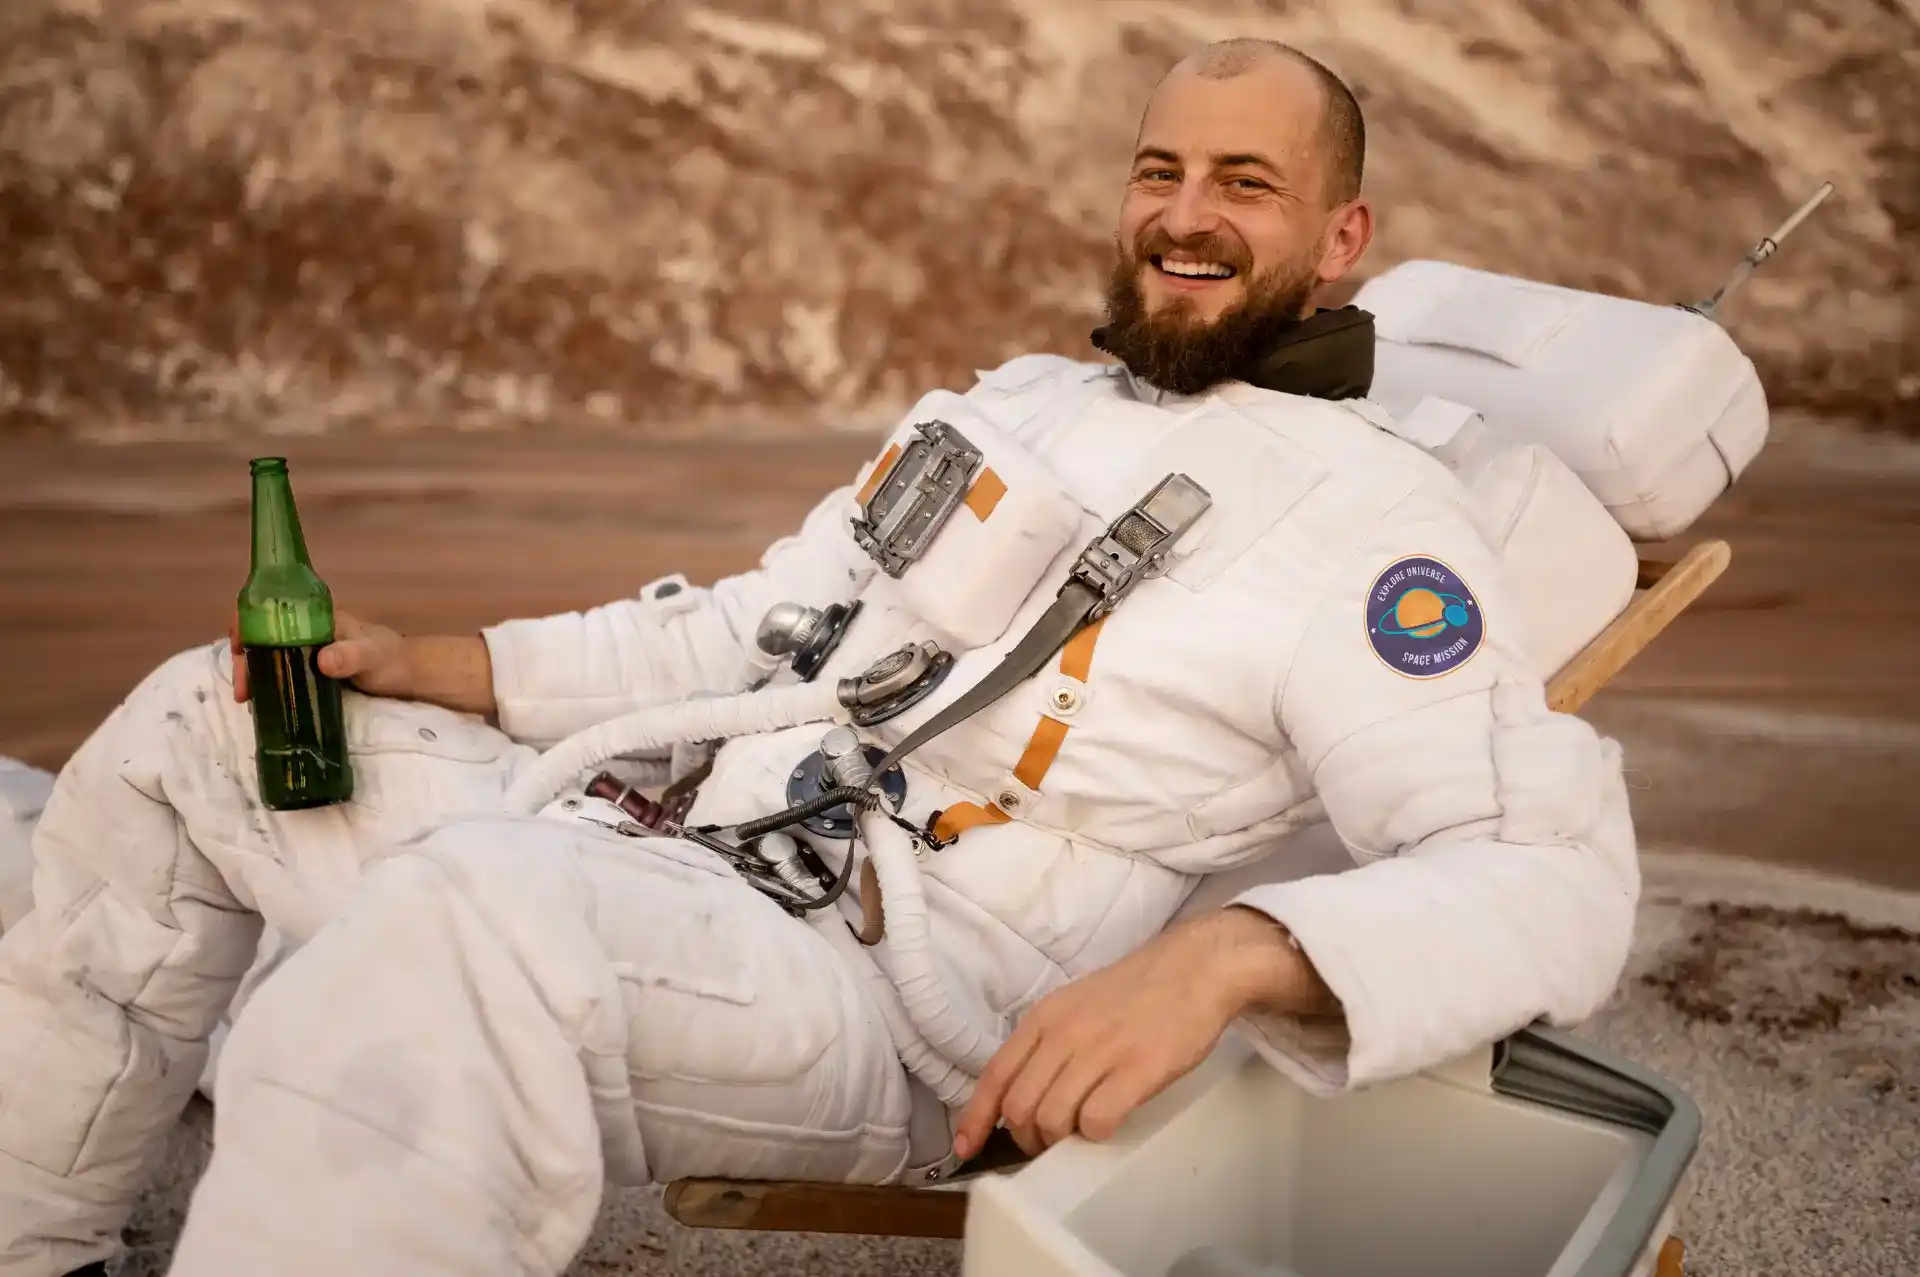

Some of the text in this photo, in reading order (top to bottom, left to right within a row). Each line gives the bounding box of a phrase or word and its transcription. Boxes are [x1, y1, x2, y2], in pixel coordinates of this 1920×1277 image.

[1377, 566, 1447, 602] EXPLORE UNIVERSE
[1402, 636, 1469, 666] SPACE MISSION
